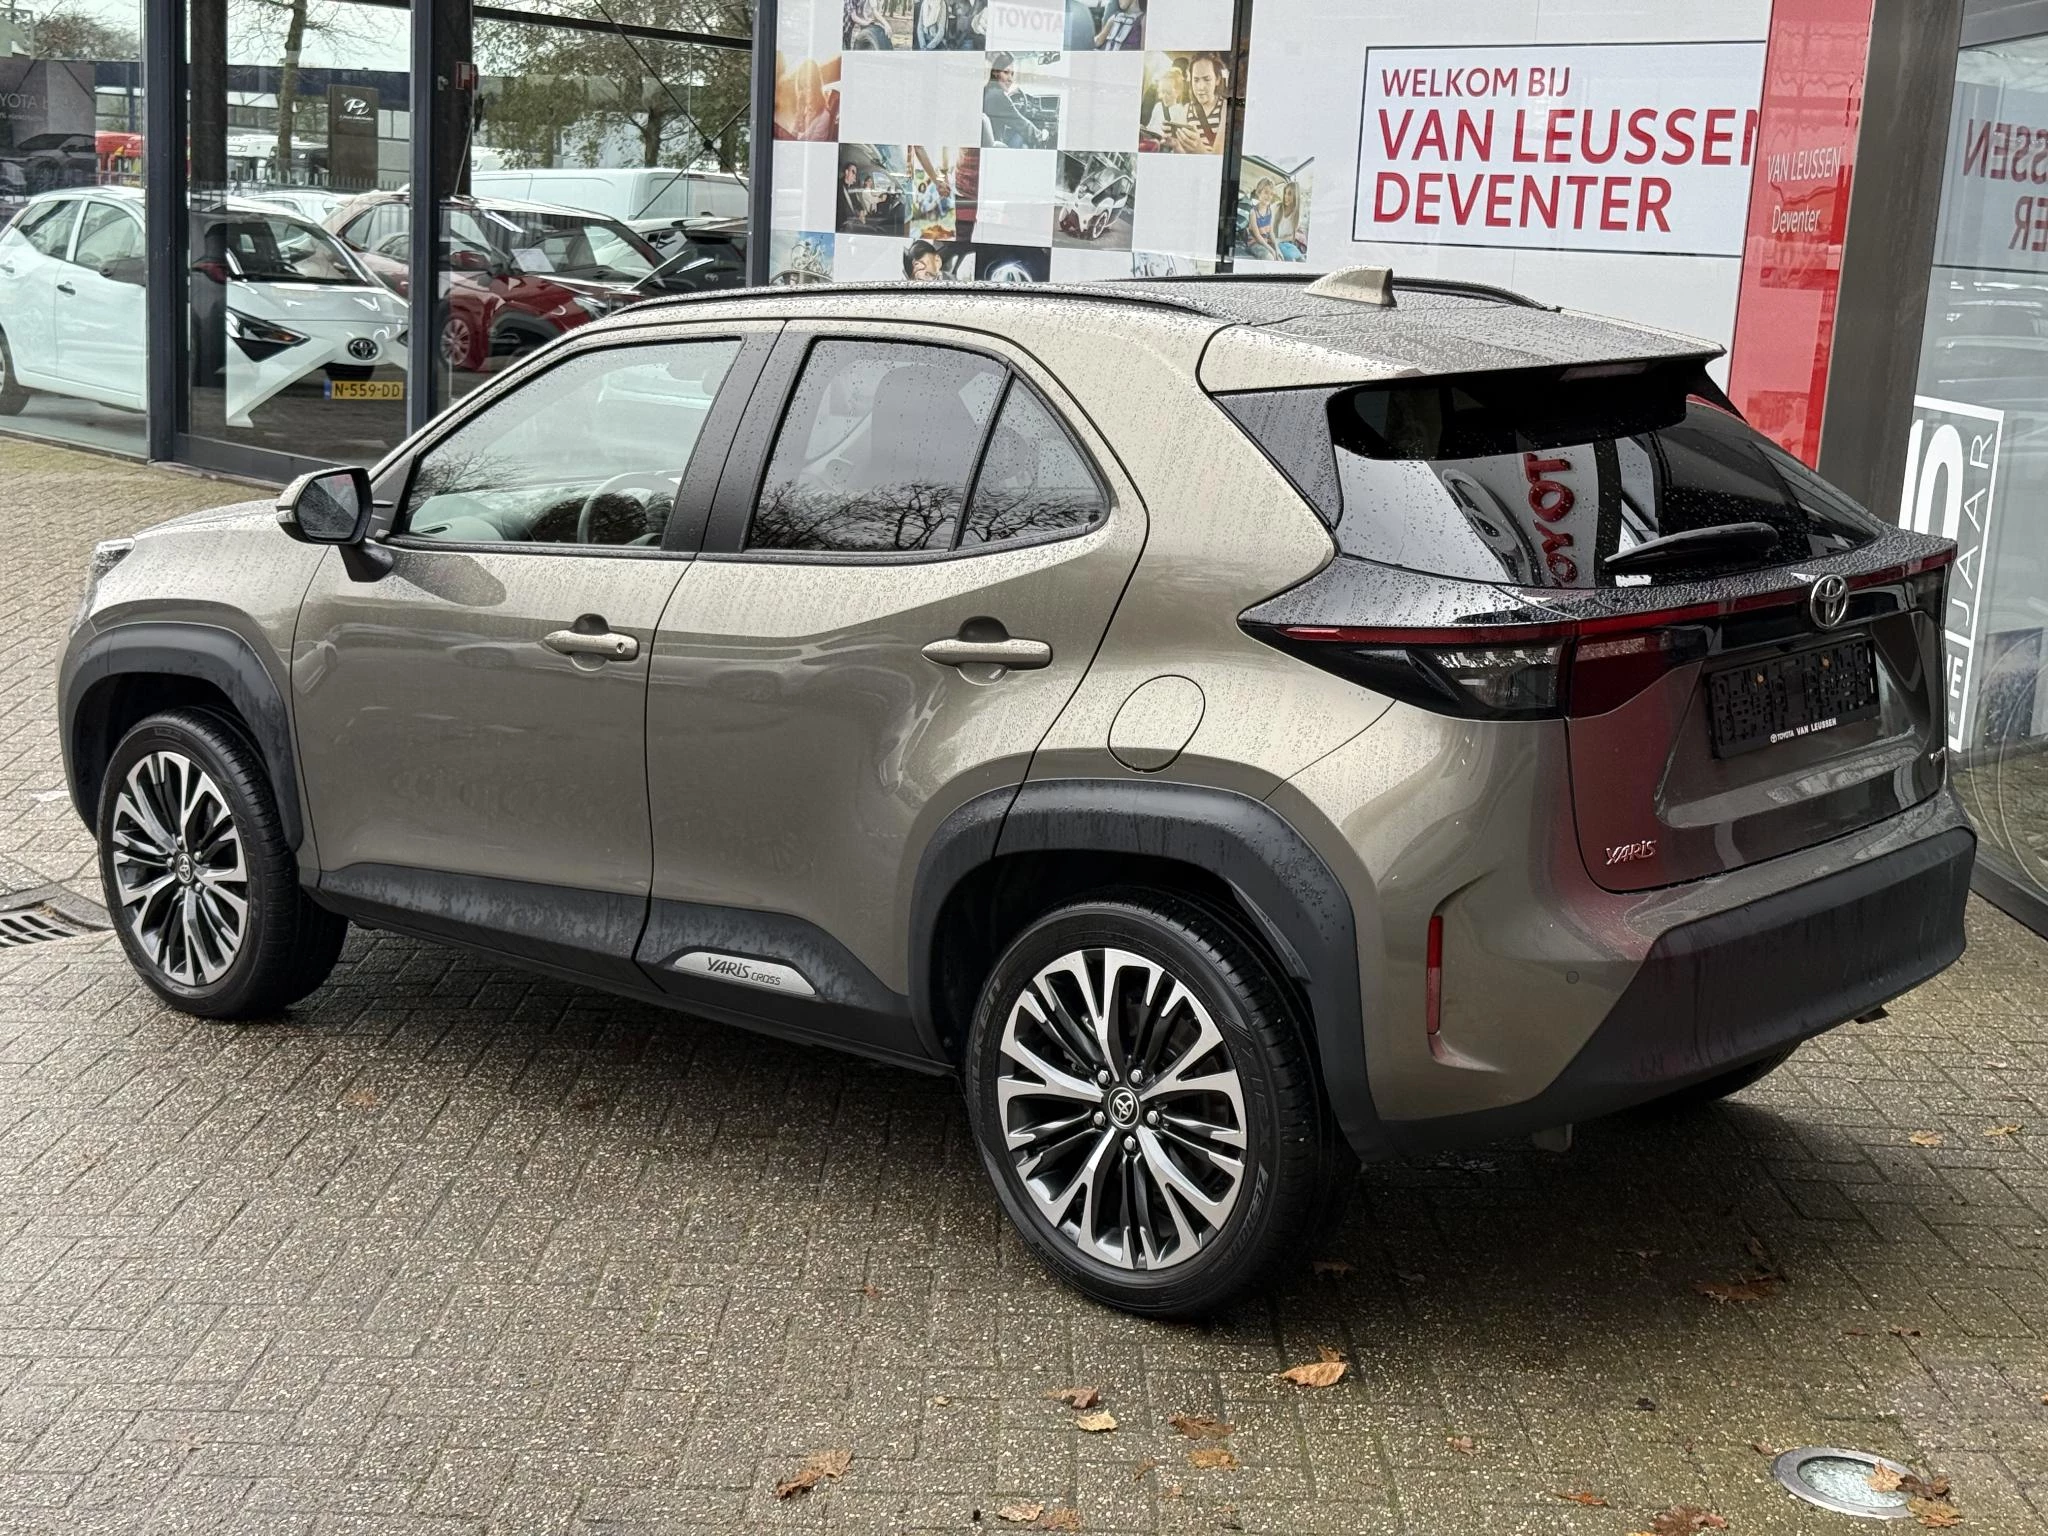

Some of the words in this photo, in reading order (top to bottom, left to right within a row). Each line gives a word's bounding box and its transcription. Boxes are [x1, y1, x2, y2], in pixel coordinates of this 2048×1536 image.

[996, 6, 1063, 33] TOYOTA
[1381, 67, 1518, 97] WELKOM
[1528, 67, 1571, 97] BIJ
[1378, 109, 1494, 162] VAN
[1767, 152, 1790, 183] VAN
[1790, 146, 1842, 181] LEUSSEN
[1373, 171, 1672, 232] DEVENTER
[1771, 204, 1821, 233] Deventer
[334, 383, 400, 397] N-559-DD
[1951, 433, 1993, 627] JAAR
[1796, 725, 1809, 736] VAN
[1810, 717, 1837, 732] LEUSSEN
[1606, 840, 1656, 865] YARIS
[707, 957, 751, 979] YARIS
[751, 972, 781, 986] CROSS
